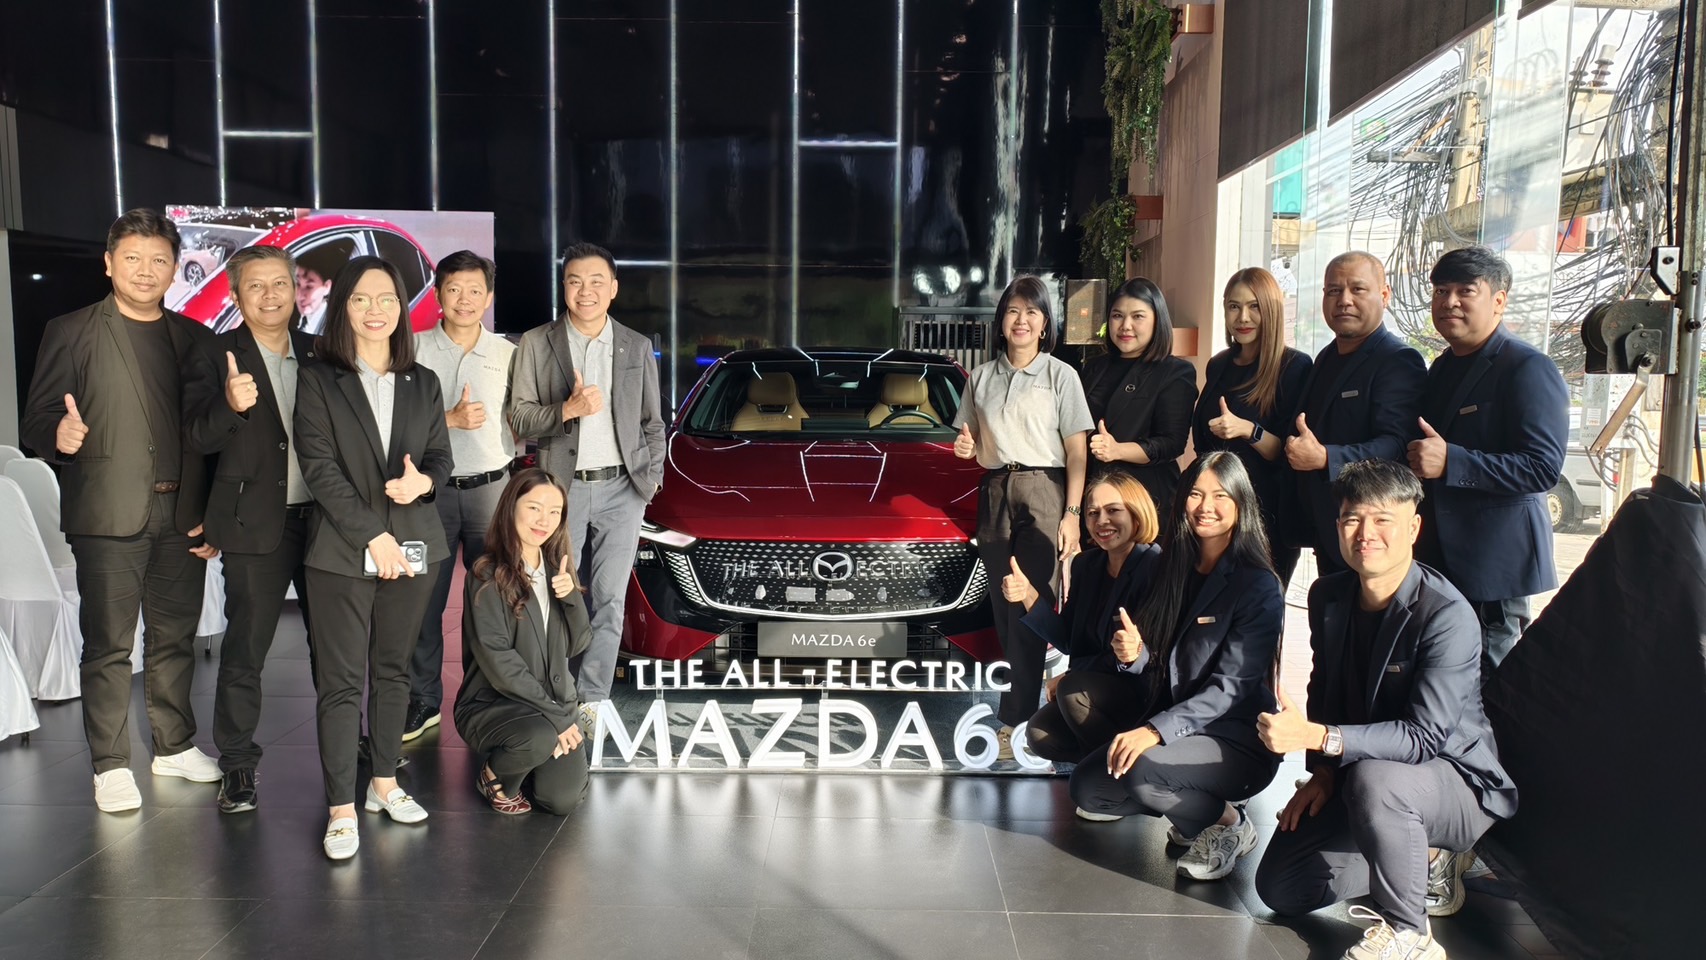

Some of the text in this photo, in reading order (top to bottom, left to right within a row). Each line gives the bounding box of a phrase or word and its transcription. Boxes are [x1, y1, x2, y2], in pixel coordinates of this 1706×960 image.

[791, 633, 877, 647] MAZDA 6e
[629, 659, 706, 690] THE
[590, 698, 944, 769] MAZDA
